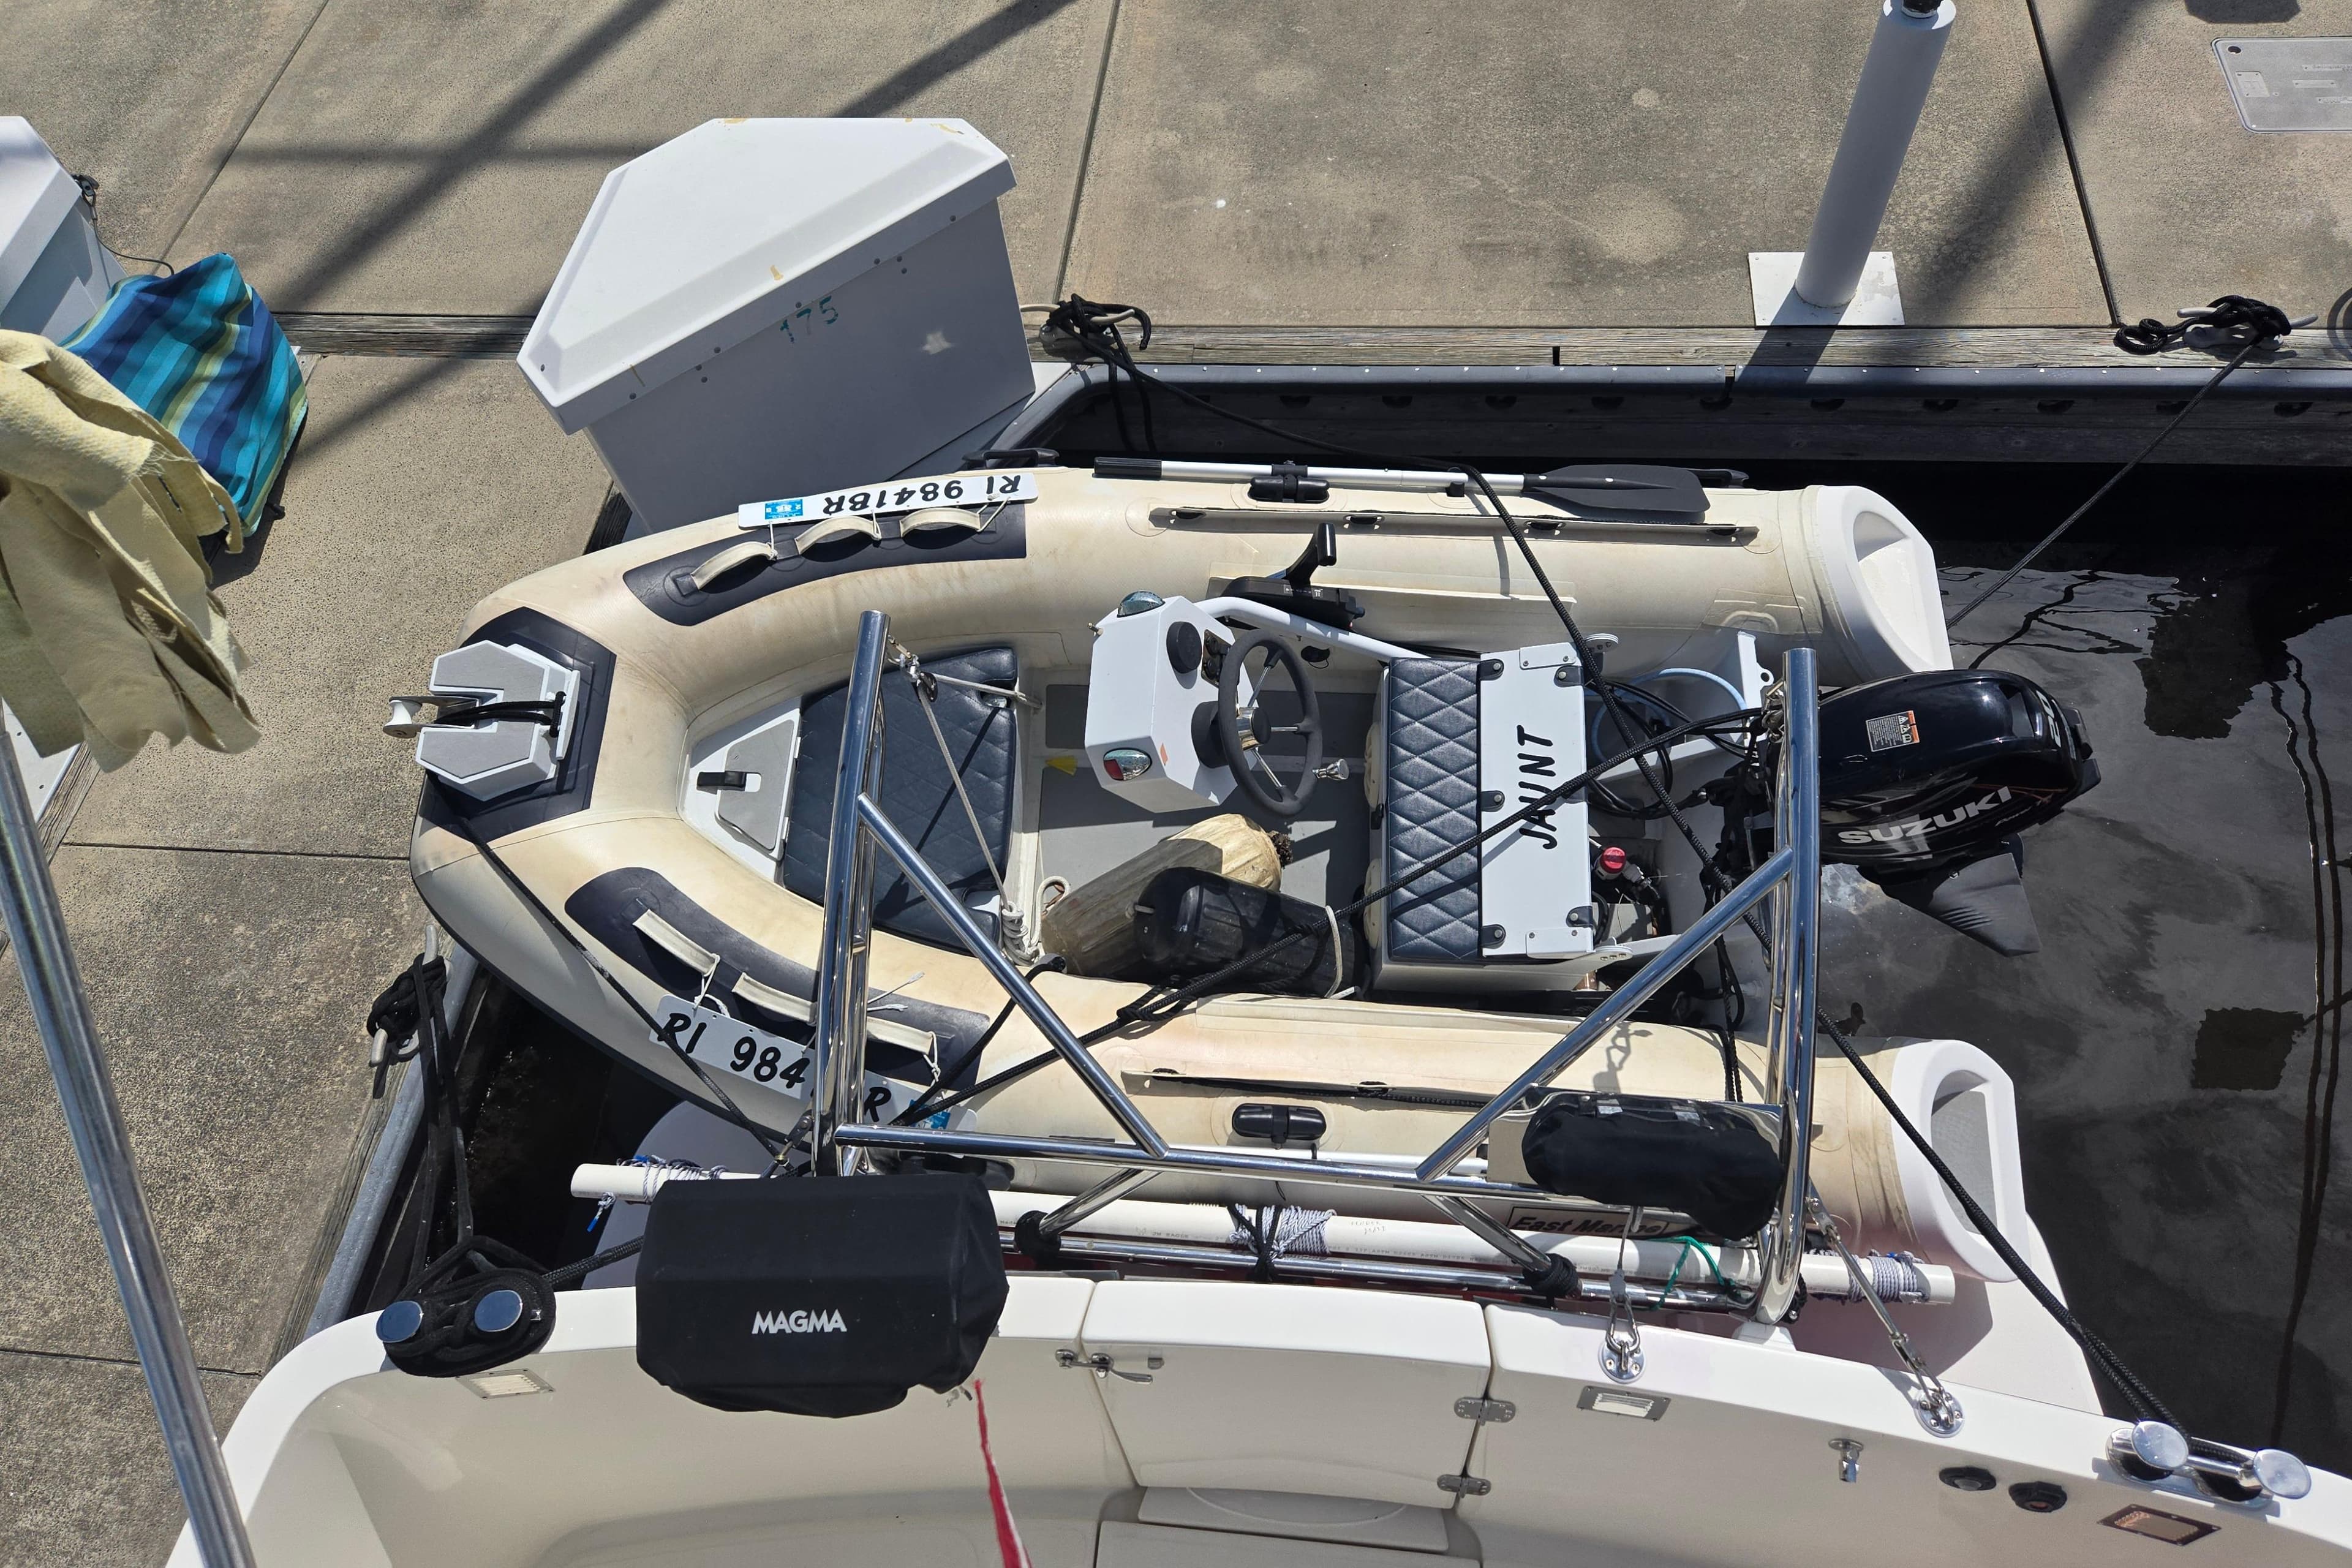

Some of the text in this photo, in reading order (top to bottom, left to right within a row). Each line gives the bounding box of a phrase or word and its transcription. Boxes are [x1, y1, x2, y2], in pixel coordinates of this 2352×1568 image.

[779, 295, 839, 344] 175
[822, 474, 1021, 515] RI 9841BR
[1517, 725, 1558, 850] JAUNT
[1838, 786, 2013, 844] SUZUKI
[657, 1012, 892, 1123] RI 984R
[1511, 1216, 1575, 1232] East
[752, 1309, 848, 1335] MAGMA
